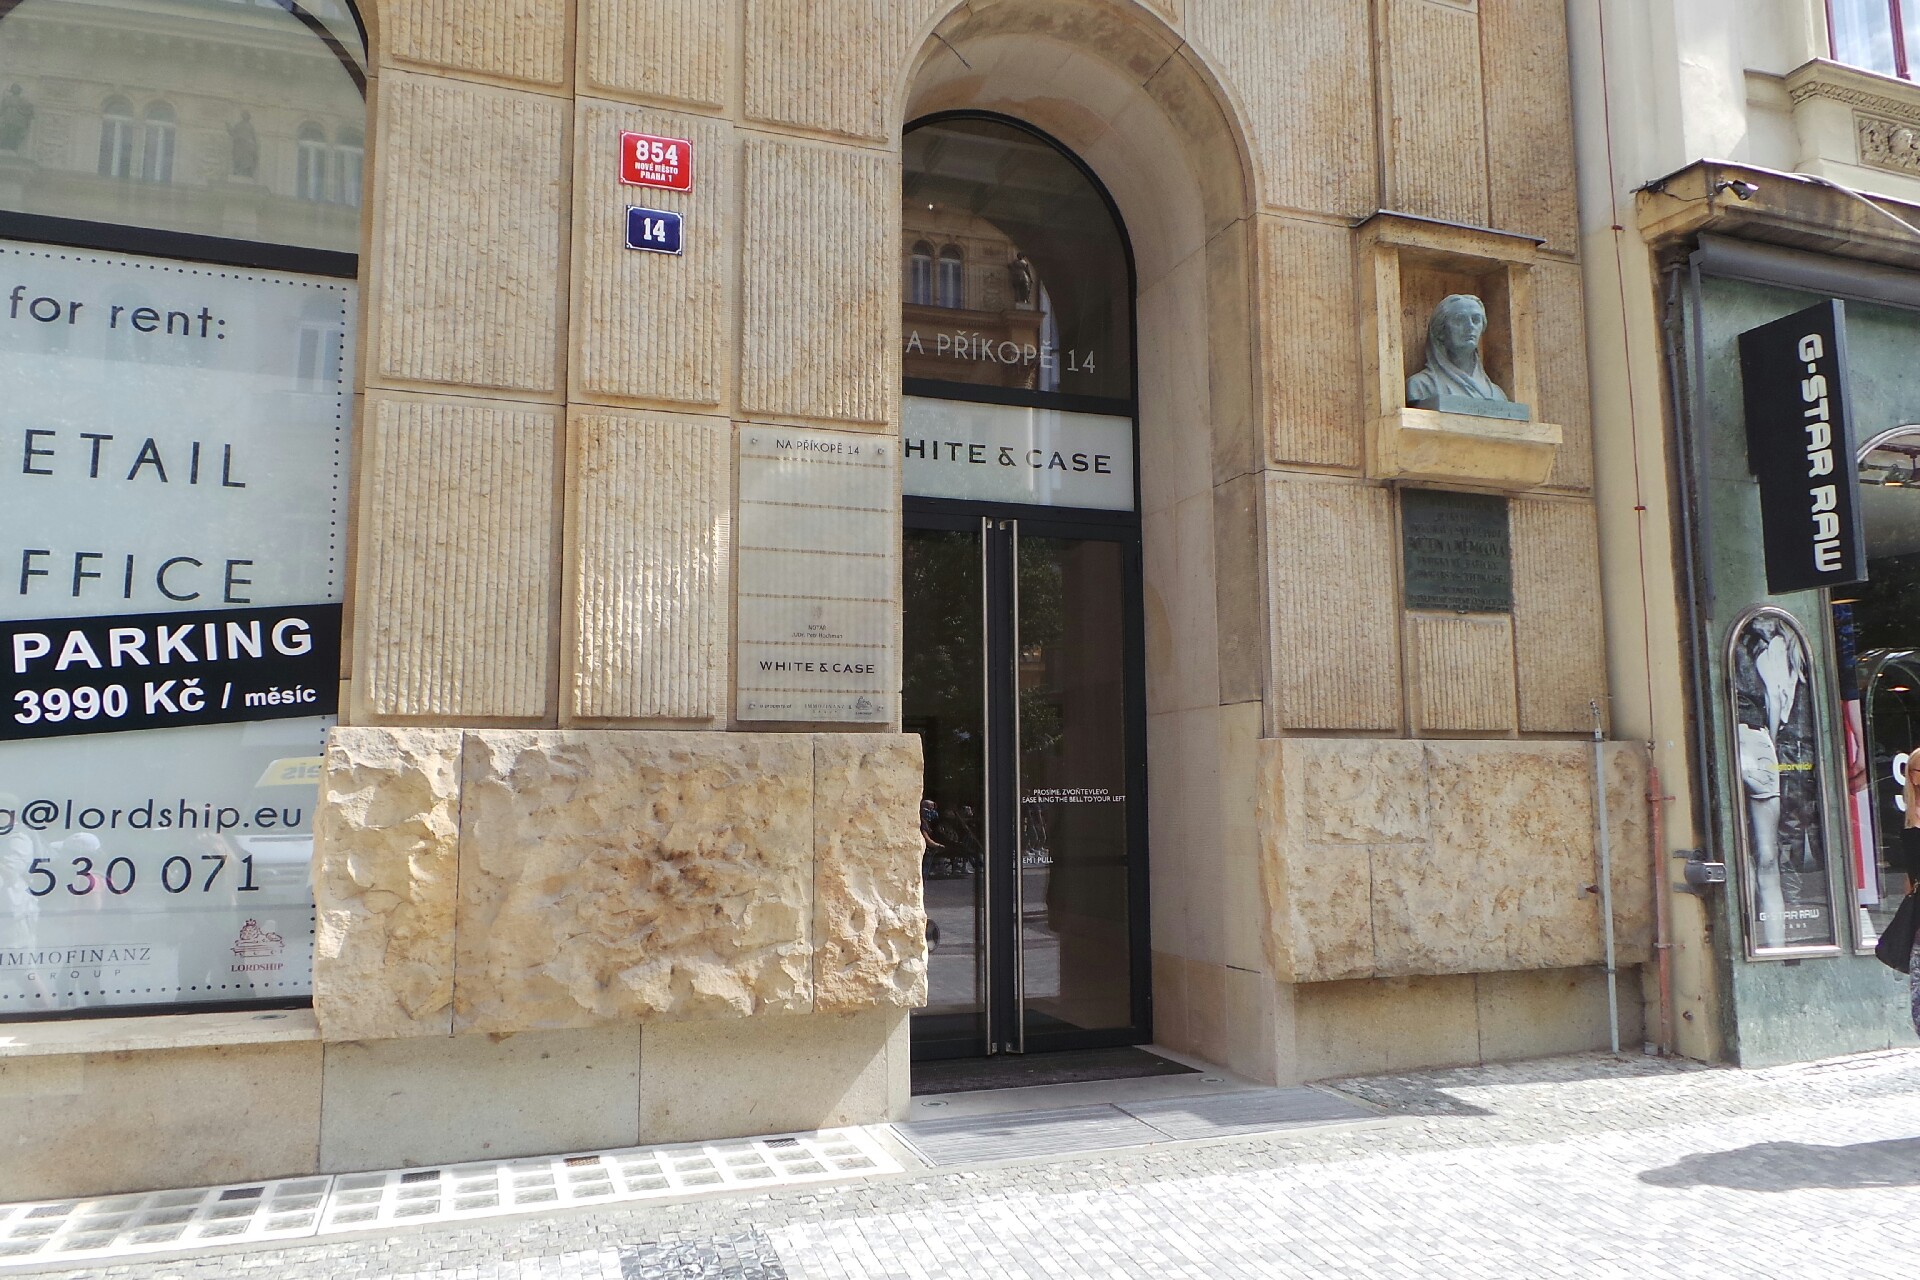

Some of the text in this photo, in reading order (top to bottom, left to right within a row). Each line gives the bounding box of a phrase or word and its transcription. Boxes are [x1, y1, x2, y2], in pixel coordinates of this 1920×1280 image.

[635, 162, 678, 174] NOVÉ MĚSTO
[636, 140, 678, 165] 854
[640, 172, 672, 182] PRAHA 1
[644, 218, 665, 242] 14
[10, 285, 227, 341] for rent:
[937, 329, 1054, 370] PŘÍKOPĚ
[1066, 348, 1096, 374] 14
[22, 428, 247, 489] ETAIL
[776, 439, 860, 455] NA PŘÍKOPĚ 14
[904, 437, 1112, 475] HITE & CASE
[1810, 484, 1843, 572] RAW
[19, 549, 255, 604] FFICE
[12, 617, 313, 674] PARKING
[760, 660, 875, 674] WHITE & CASE
[13, 684, 128, 725] 3990
[144, 678, 206, 715] Kč
[244, 684, 317, 708] měsíc
[27, 855, 260, 896] 530 071
[1799, 909, 1820, 919] RAW
[27, 969, 121, 981] GROUP
[231, 962, 284, 973] LORDSHIP
